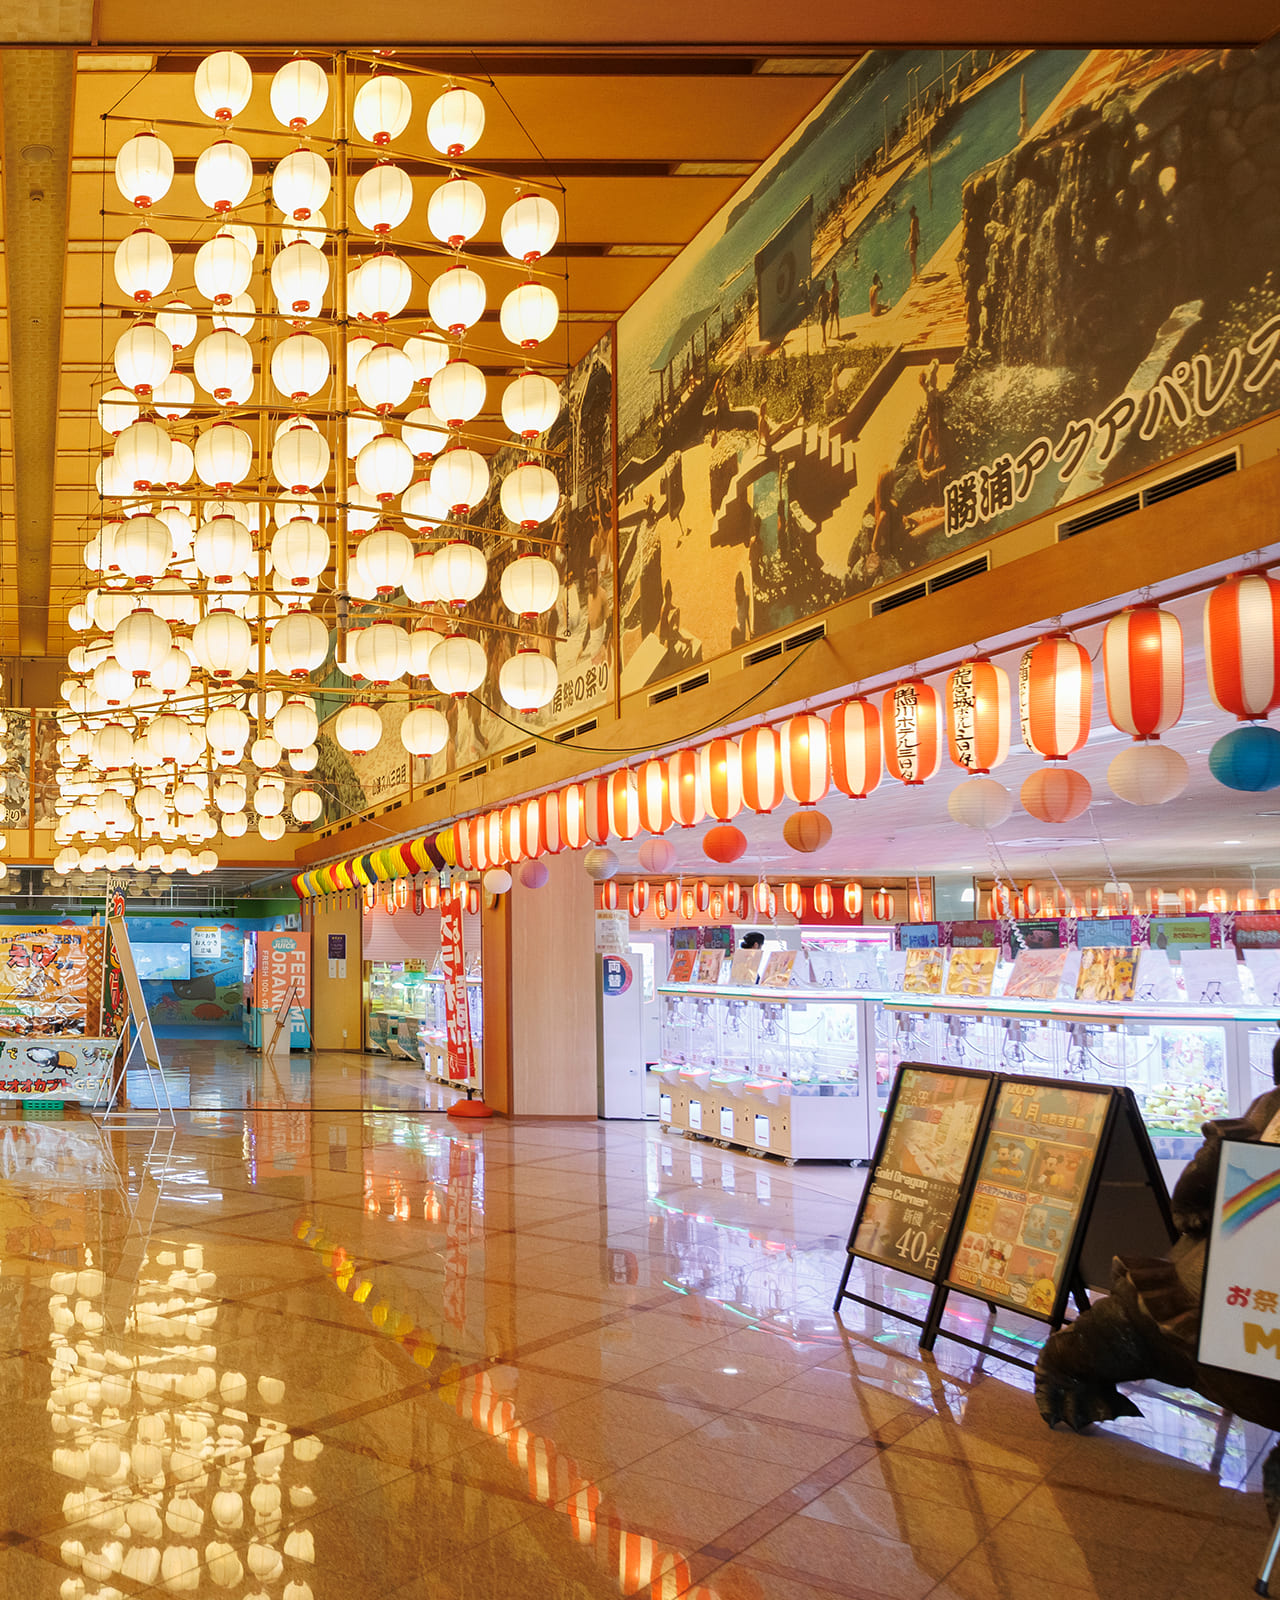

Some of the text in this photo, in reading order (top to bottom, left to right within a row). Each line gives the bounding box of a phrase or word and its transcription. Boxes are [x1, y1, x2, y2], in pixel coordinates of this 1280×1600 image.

[943, 315, 1280, 538] 勝浦アクアパレス
[552, 661, 609, 714] 房総の祭り
[6, 944, 60, 968] えび
[273, 941, 296, 950] JUICE
[271, 951, 287, 1013] ORANG
[290, 950, 306, 1033] FEED ME
[607, 960, 622, 988] 両替
[870, 1183, 929, 1208] Game Corner
[874, 1166, 929, 1190] Gold Dragon
[895, 1227, 941, 1272] 40台
